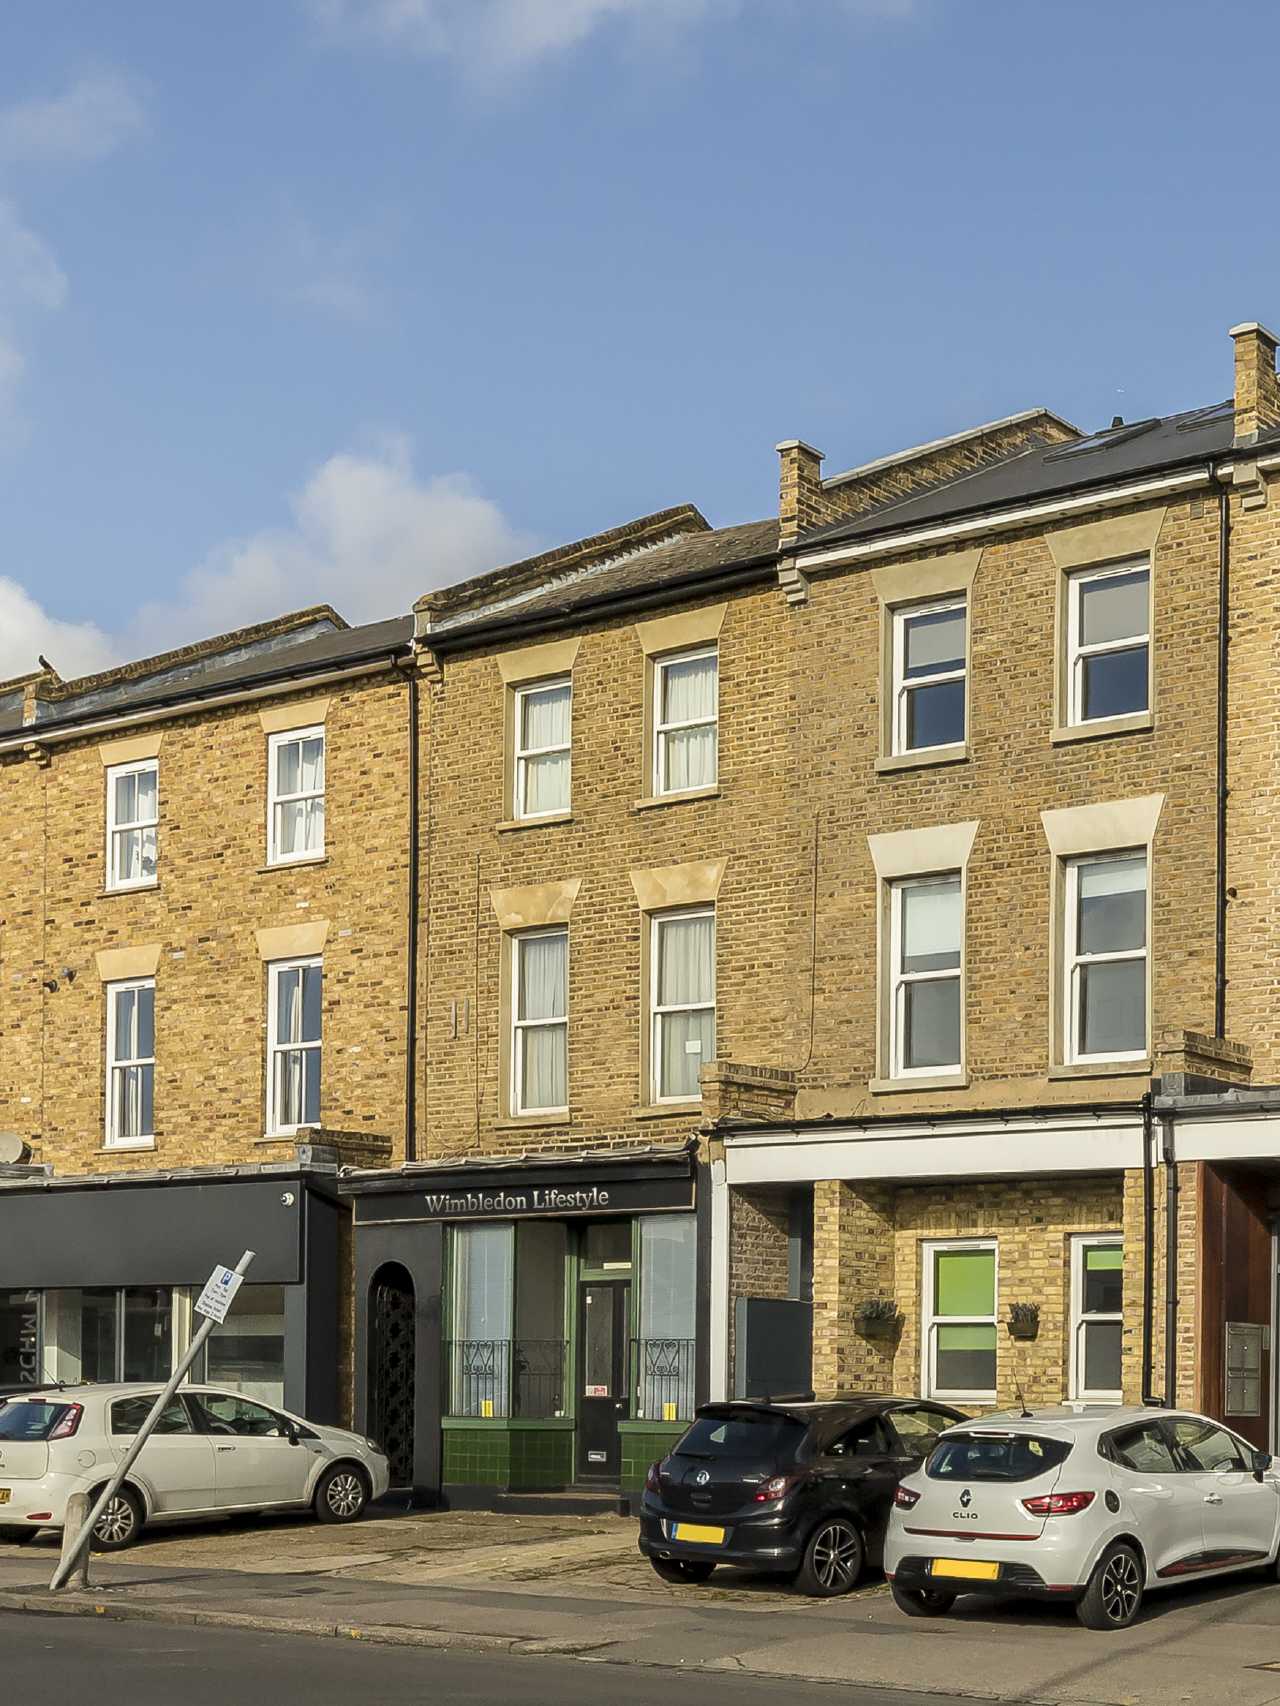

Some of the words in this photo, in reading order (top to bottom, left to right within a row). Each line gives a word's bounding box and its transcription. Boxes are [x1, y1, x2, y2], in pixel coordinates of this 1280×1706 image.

[425, 1192, 527, 1213] Wimbledon
[532, 1187, 609, 1211] Lifestyle
[952, 1511, 978, 1519] CLIO
